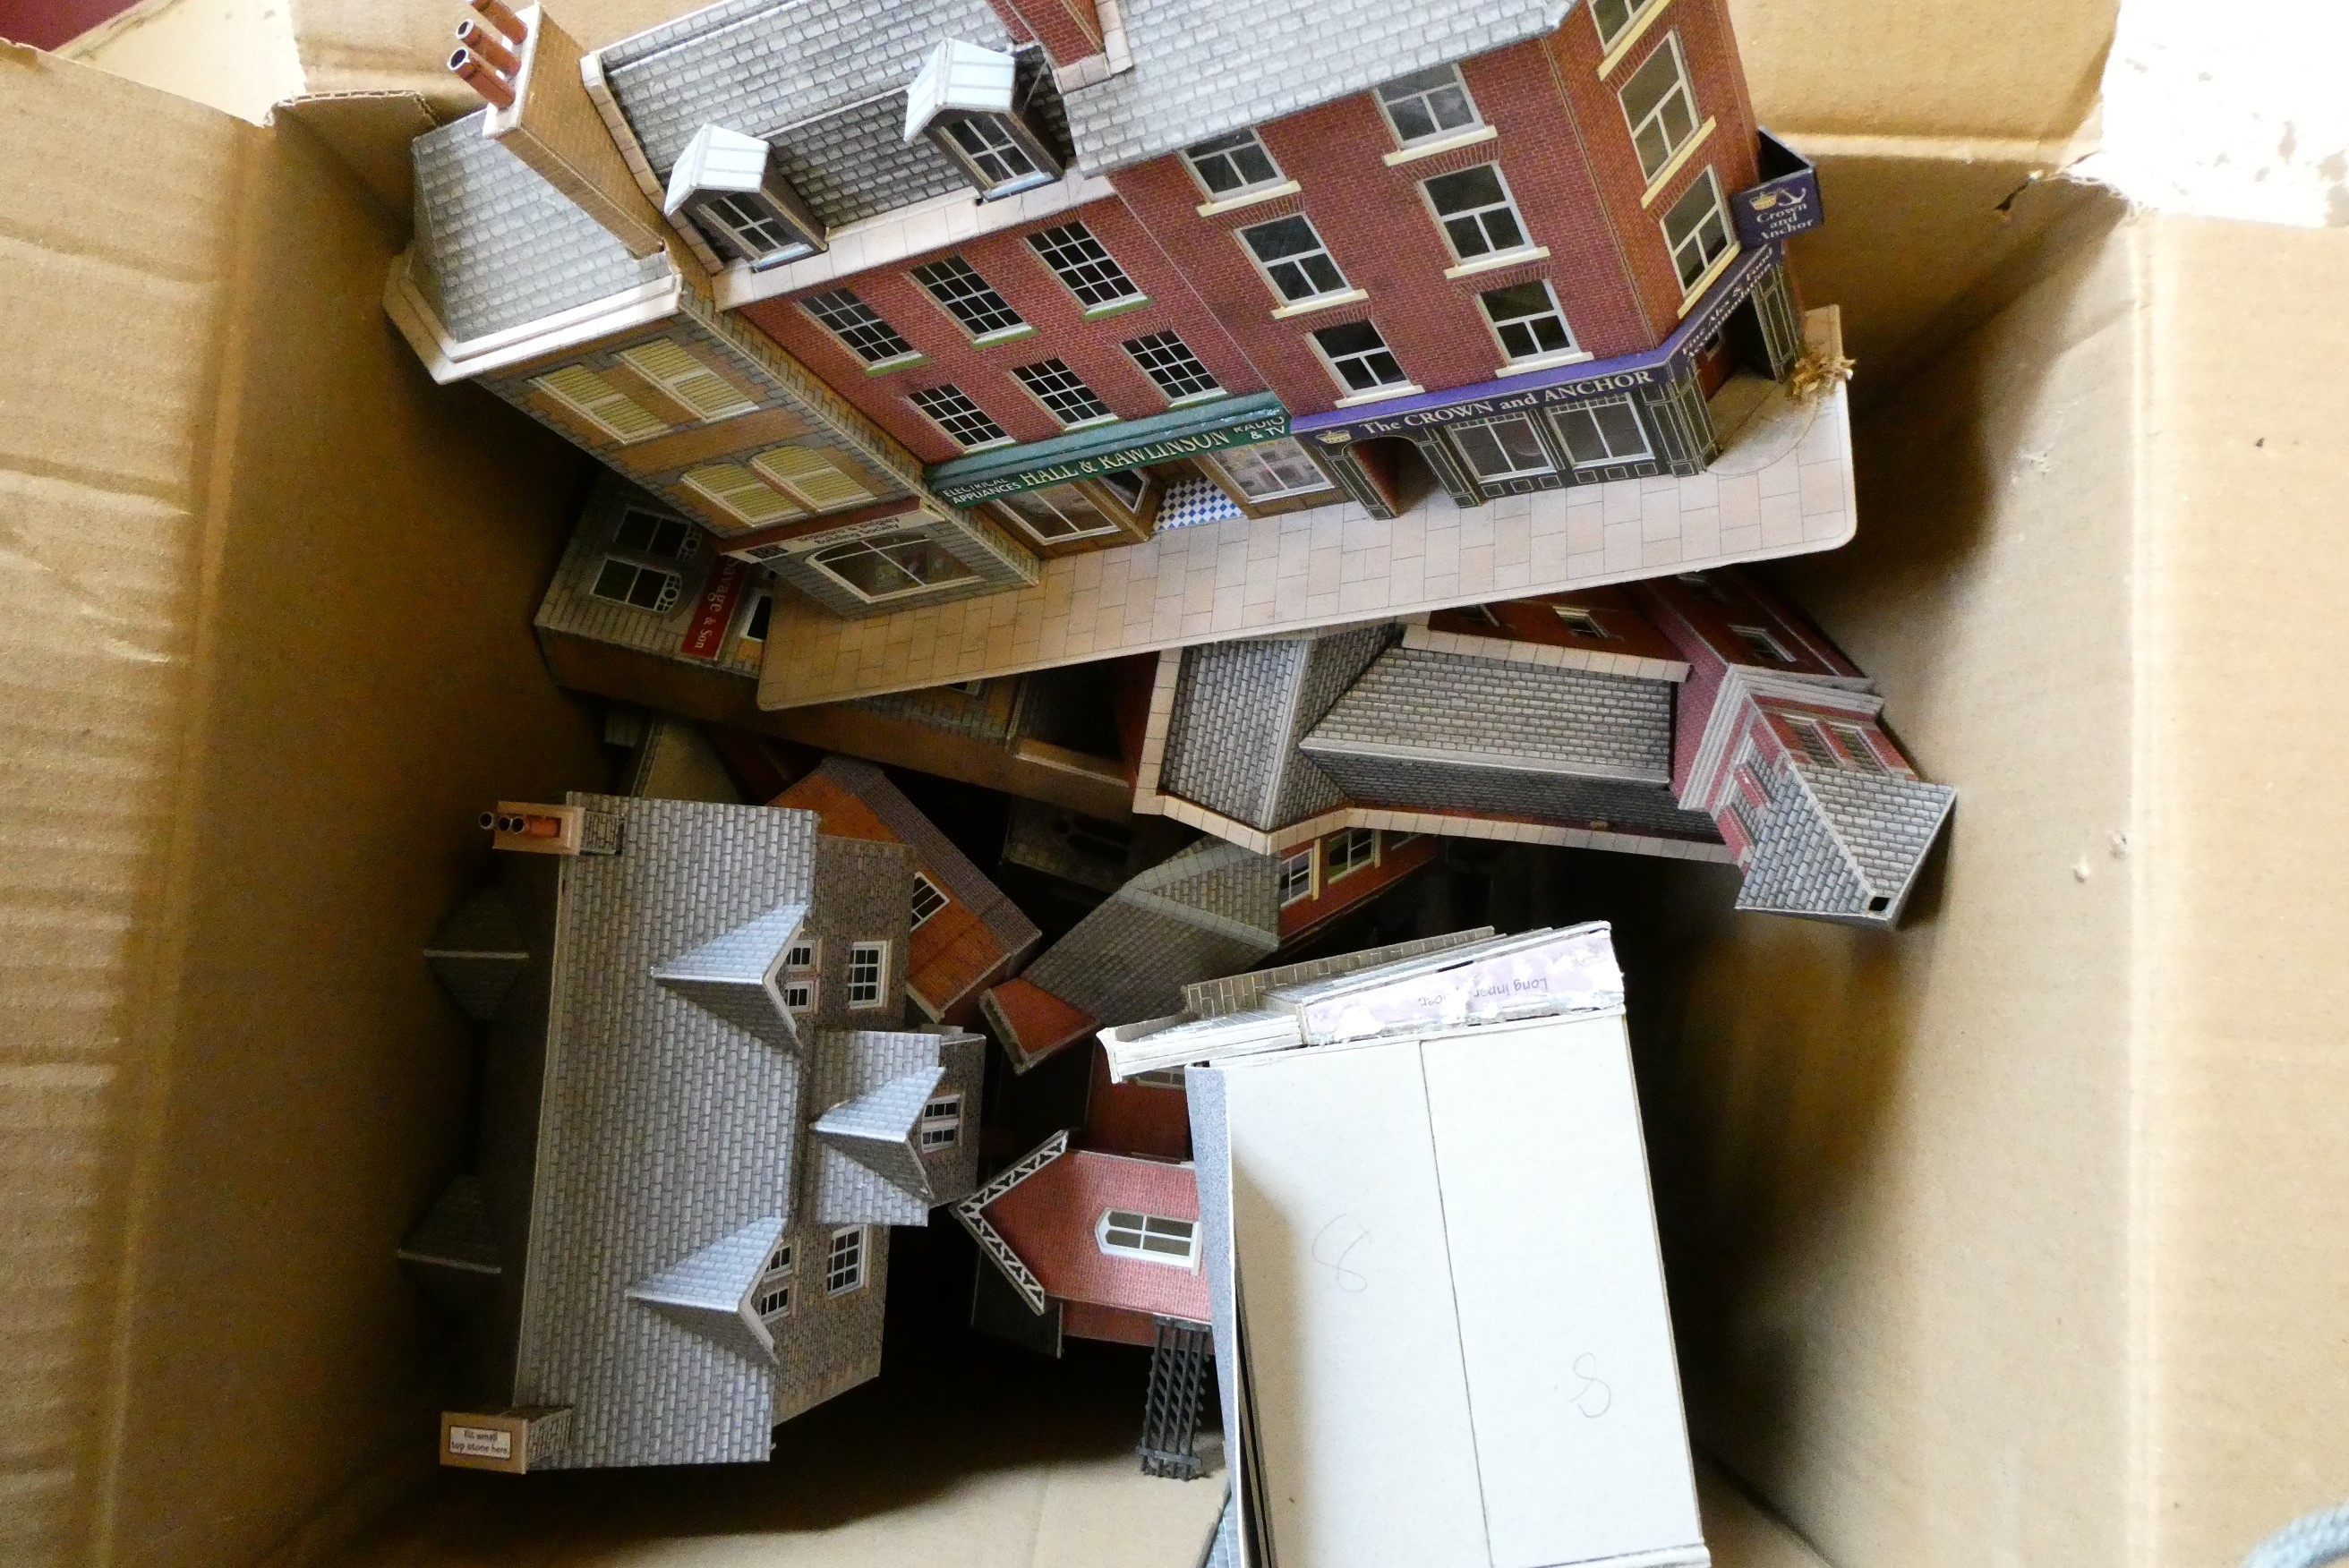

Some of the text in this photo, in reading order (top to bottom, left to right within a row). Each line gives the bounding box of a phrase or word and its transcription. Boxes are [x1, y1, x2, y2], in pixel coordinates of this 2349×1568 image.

[1756, 203, 1807, 222] Crown
[1770, 213, 1798, 228] and
[1761, 219, 1813, 239] Anchor
[1360, 370, 1654, 436] The CROWN and ANCHOR
[1250, 425, 1285, 439] & TV
[1020, 465, 1079, 486] HALL
[1079, 461, 1098, 473] &
[952, 482, 1021, 504] APPLIANCES
[707, 558, 740, 612] Savage
[695, 629, 712, 649] Son
[1515, 978, 1549, 991] Long
